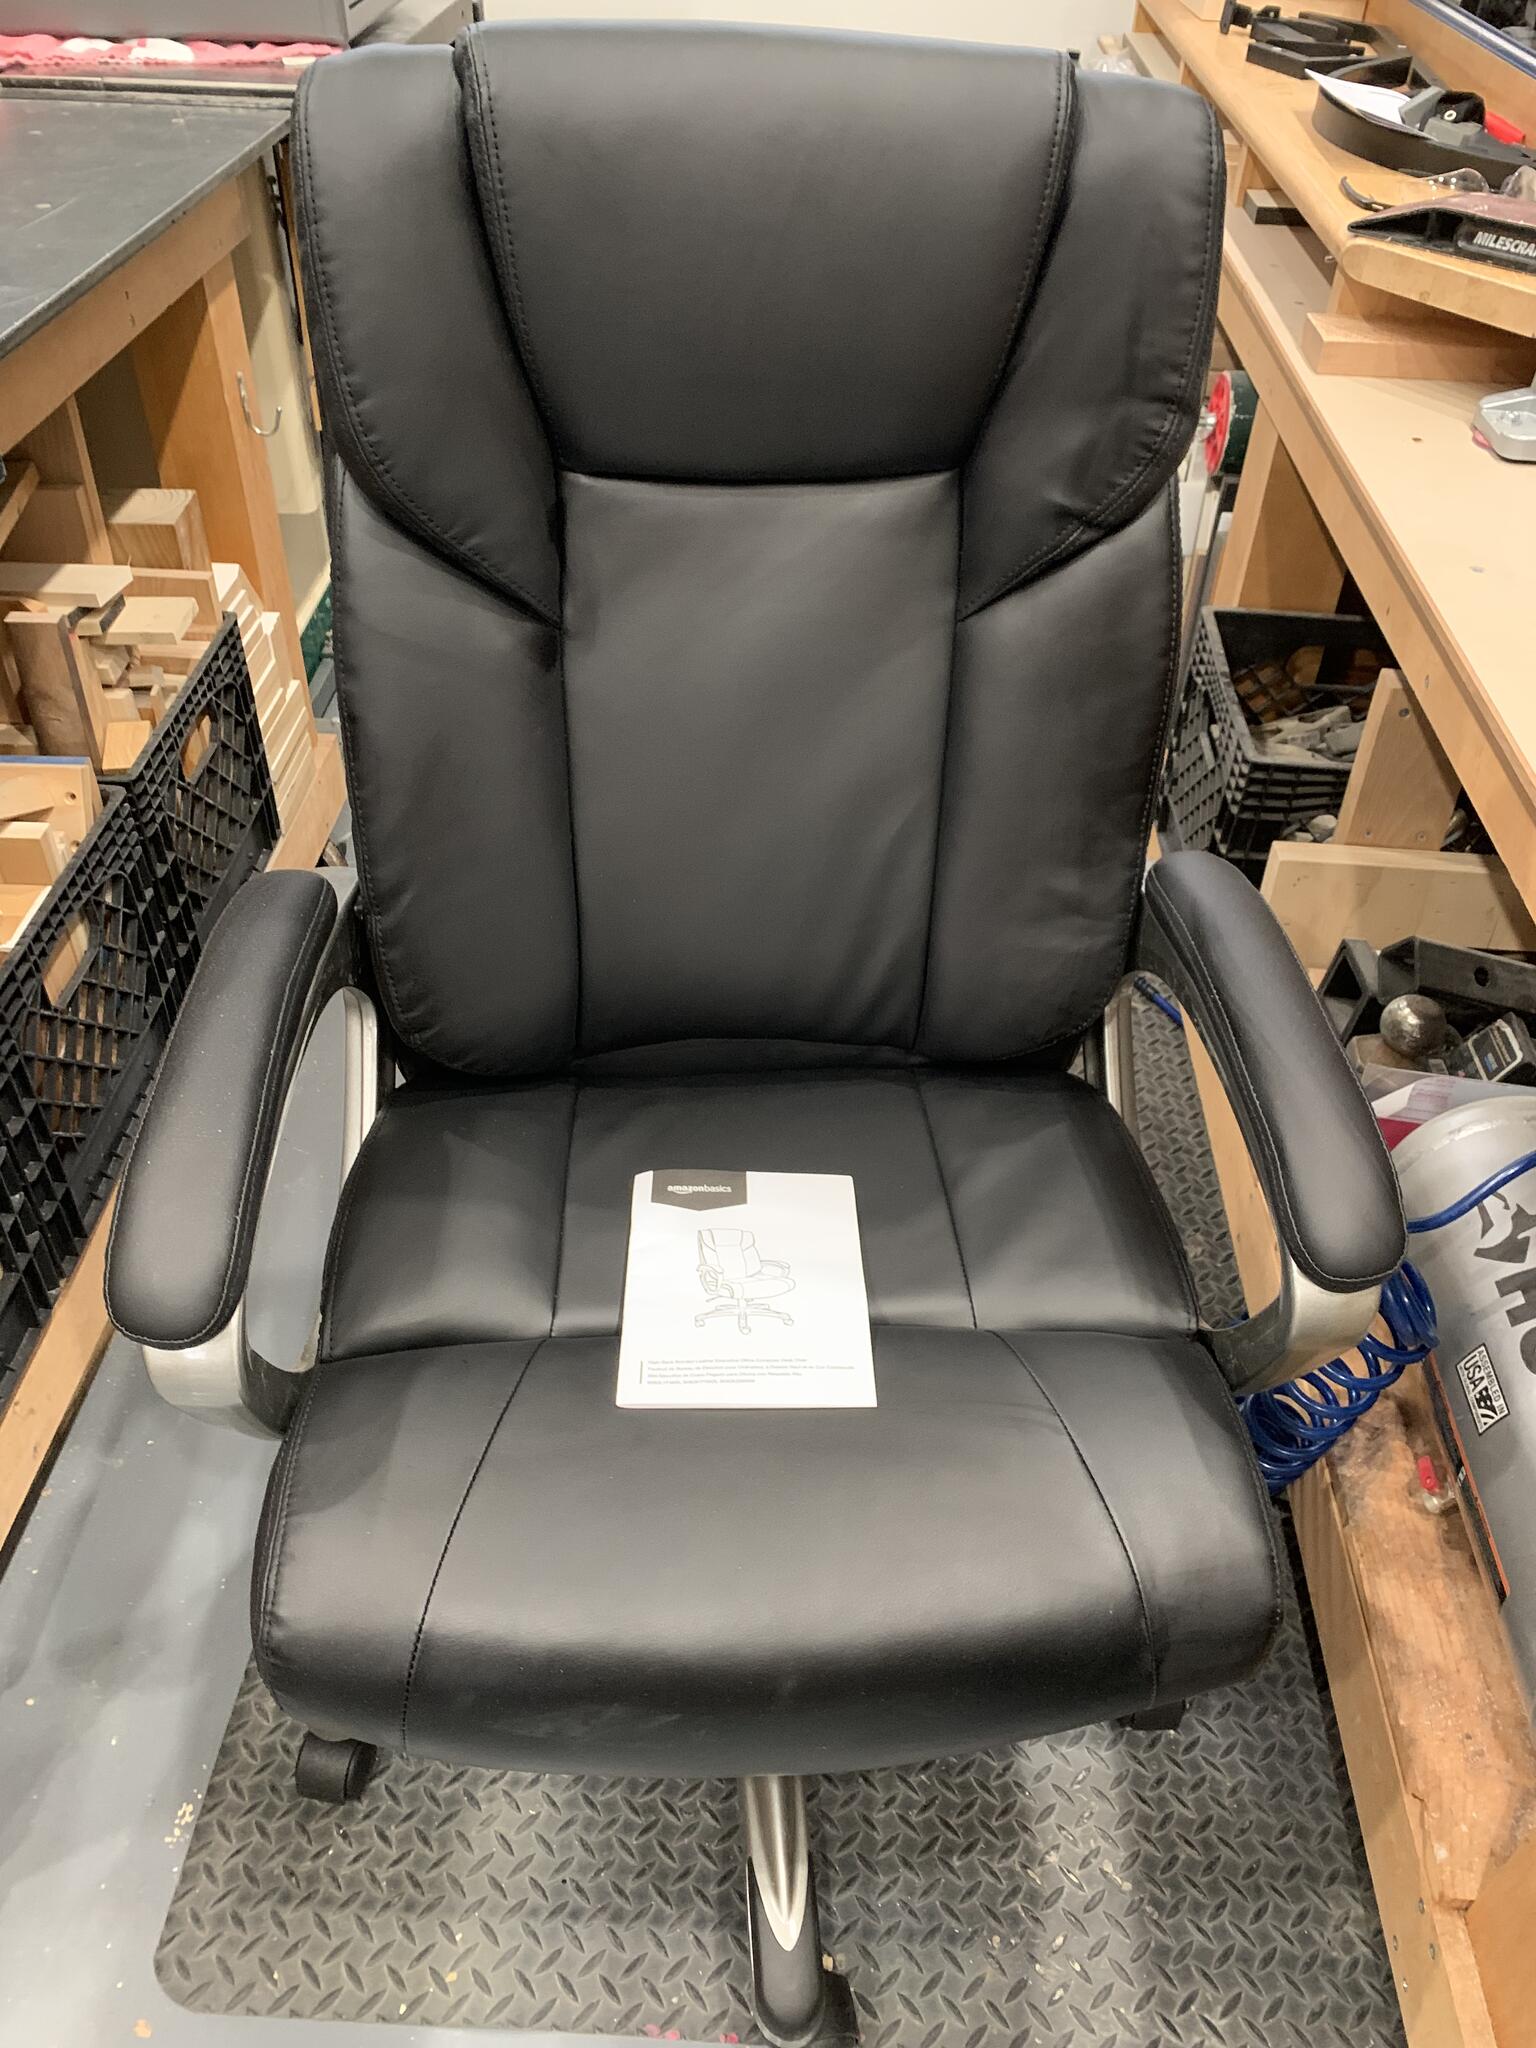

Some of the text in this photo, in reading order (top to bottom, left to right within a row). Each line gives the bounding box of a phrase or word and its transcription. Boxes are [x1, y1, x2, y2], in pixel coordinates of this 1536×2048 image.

[666, 1183, 733, 1194] amazonbasics
[1463, 1354, 1485, 1393] USA
[1477, 1350, 1506, 1415] ASSEMBLED IN
